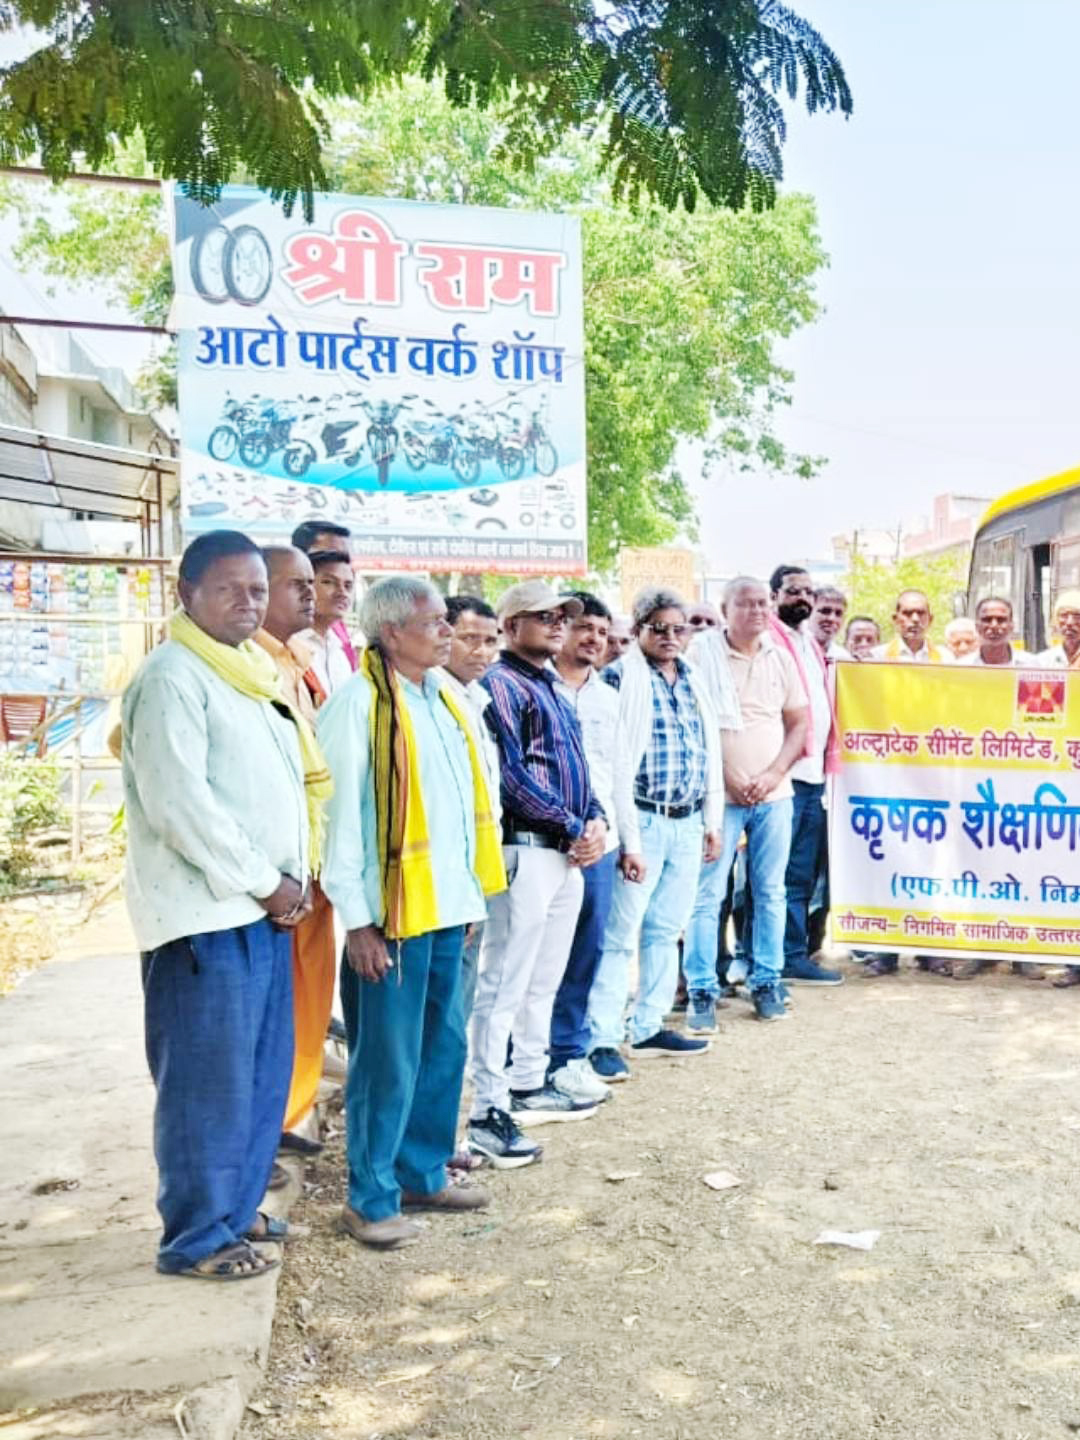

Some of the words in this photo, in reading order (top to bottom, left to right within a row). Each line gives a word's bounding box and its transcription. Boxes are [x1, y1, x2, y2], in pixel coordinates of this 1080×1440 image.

[284, 208, 406, 308] श्री
[415, 241, 569, 317] राम
[196, 314, 288, 369] आटो
[297, 317, 400, 382] पार्ट्स
[407, 323, 478, 381] वर्क
[491, 331, 567, 384] शॉप
[843, 727, 919, 757] अल्ट्राटेक
[926, 730, 974, 757] सीमेंट
[848, 794, 951, 861] कृषक
[903, 915, 957, 938] निगमित
[962, 920, 1029, 943] सामाजिक
